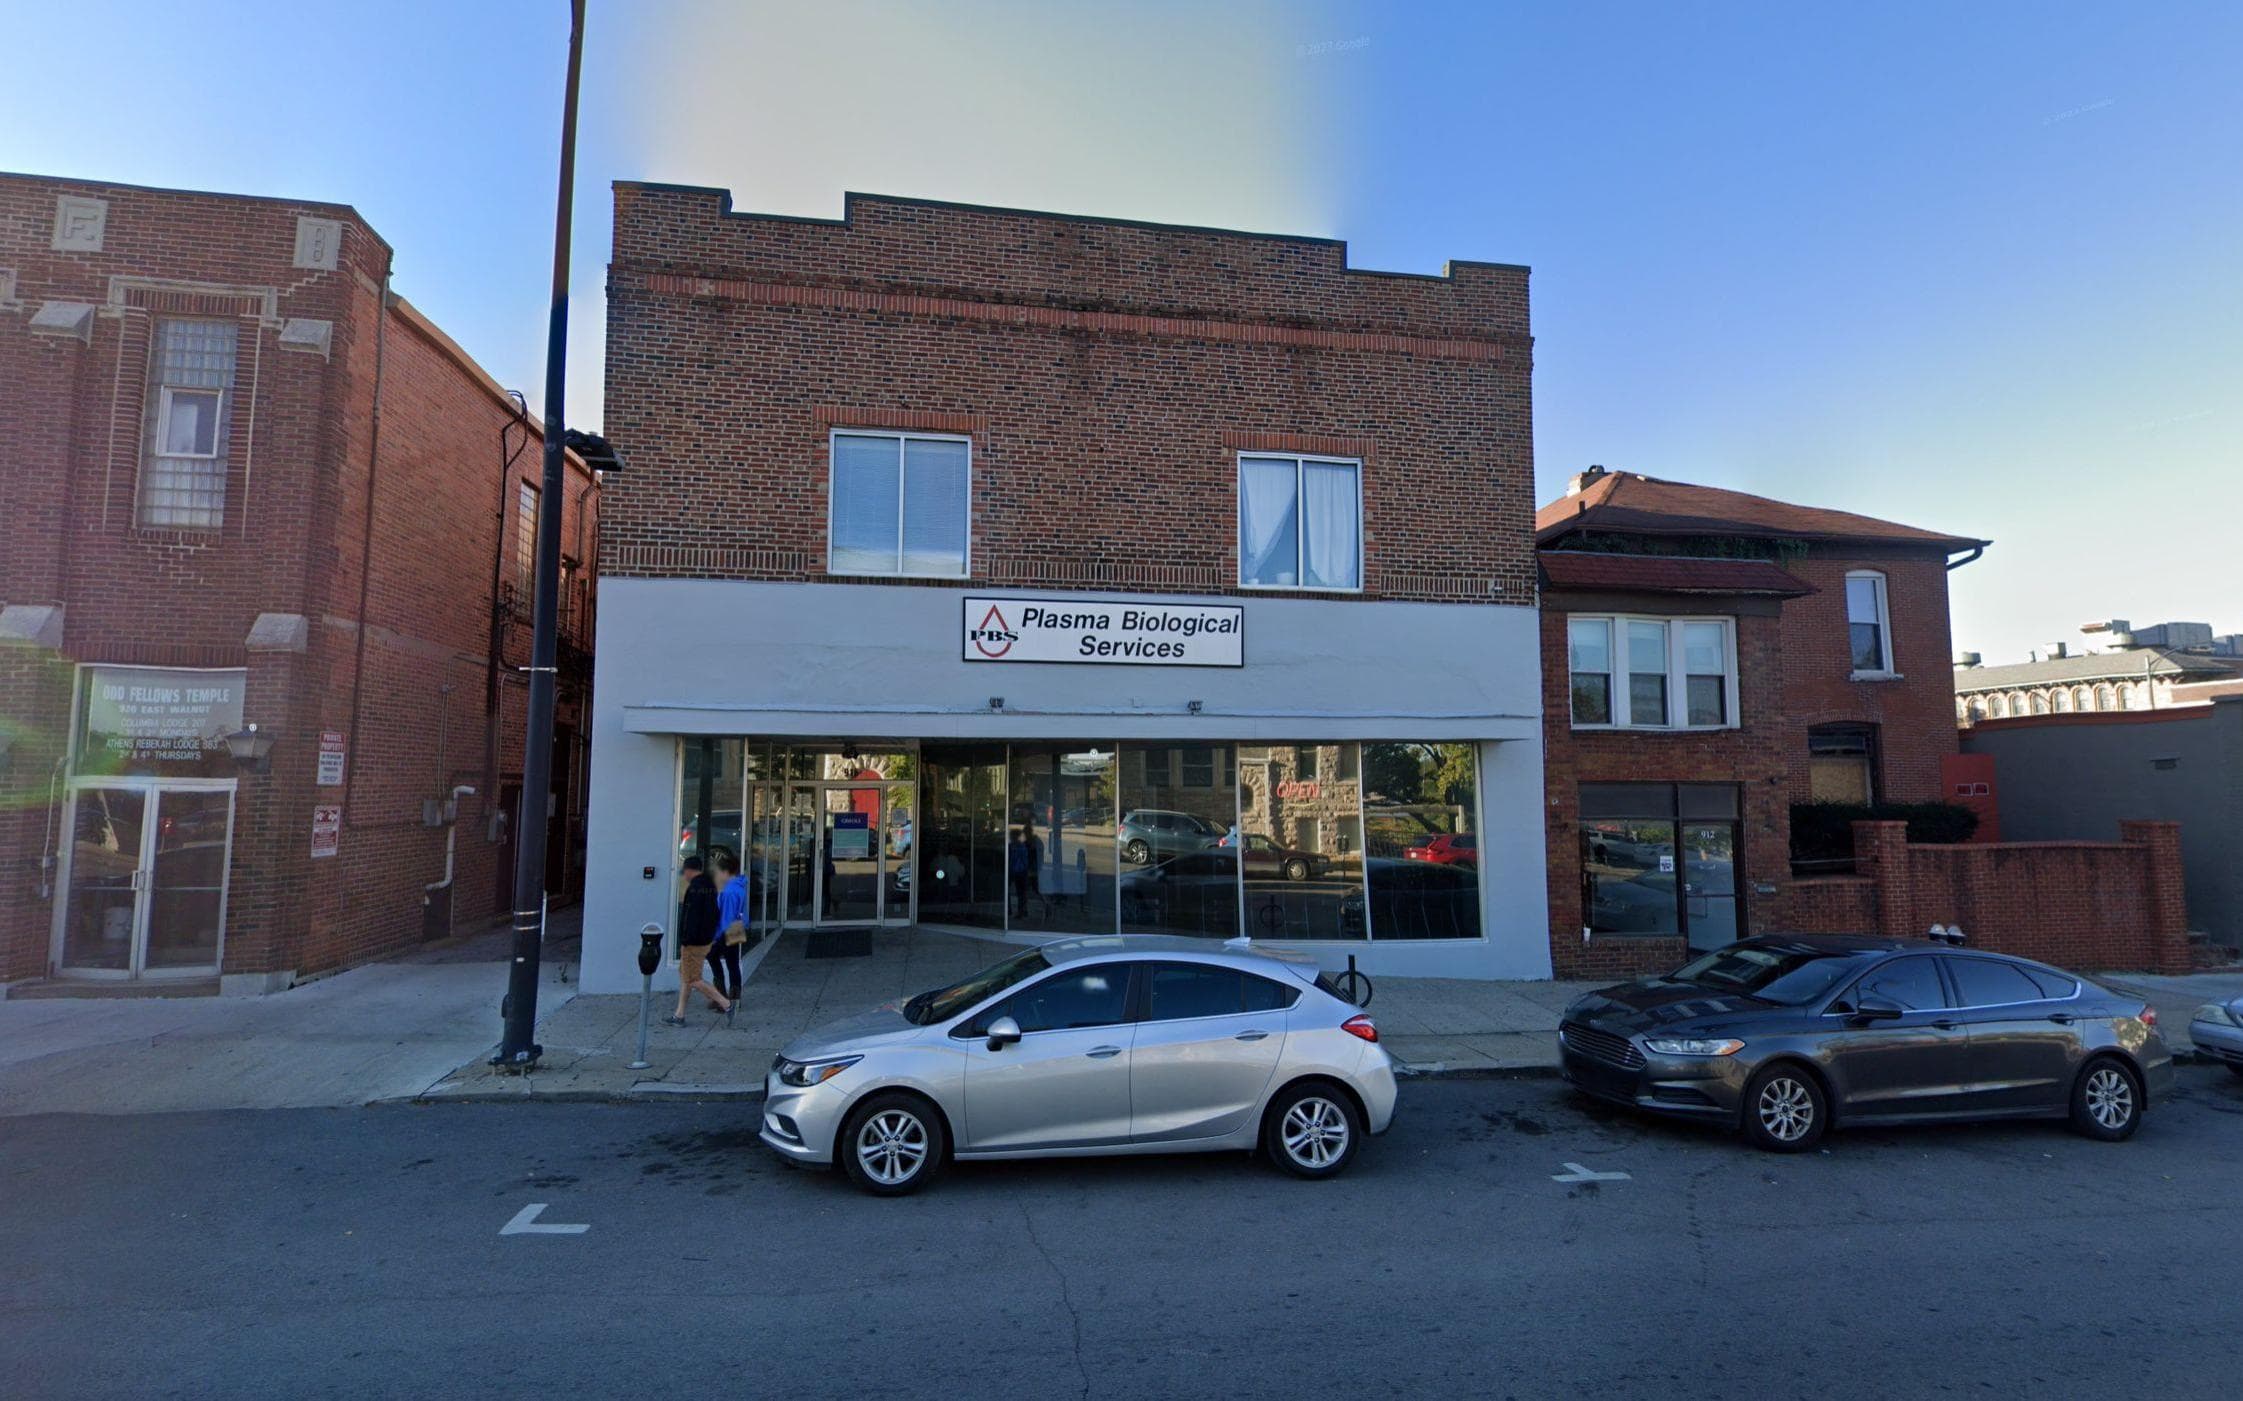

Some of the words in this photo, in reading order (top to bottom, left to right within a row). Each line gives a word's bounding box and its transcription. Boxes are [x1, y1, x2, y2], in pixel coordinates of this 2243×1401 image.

[1022, 608, 1110, 630] Plasma
[1121, 610, 1240, 637] Biological
[970, 629, 1019, 642] PBS
[1079, 635, 1186, 658] Services
[104, 686, 125, 701] ODD
[130, 687, 180, 702] FELLOWS
[186, 688, 231, 703] TEMPLE
[141, 705, 165, 714] EAST
[170, 705, 211, 714] WALNUT
[136, 739, 172, 749] REBEKAH
[173, 739, 200, 749] LODGE
[154, 751, 201, 761] THURSDAYS
[1277, 780, 1320, 800] OPEN
[1700, 830, 1715, 839] 912
